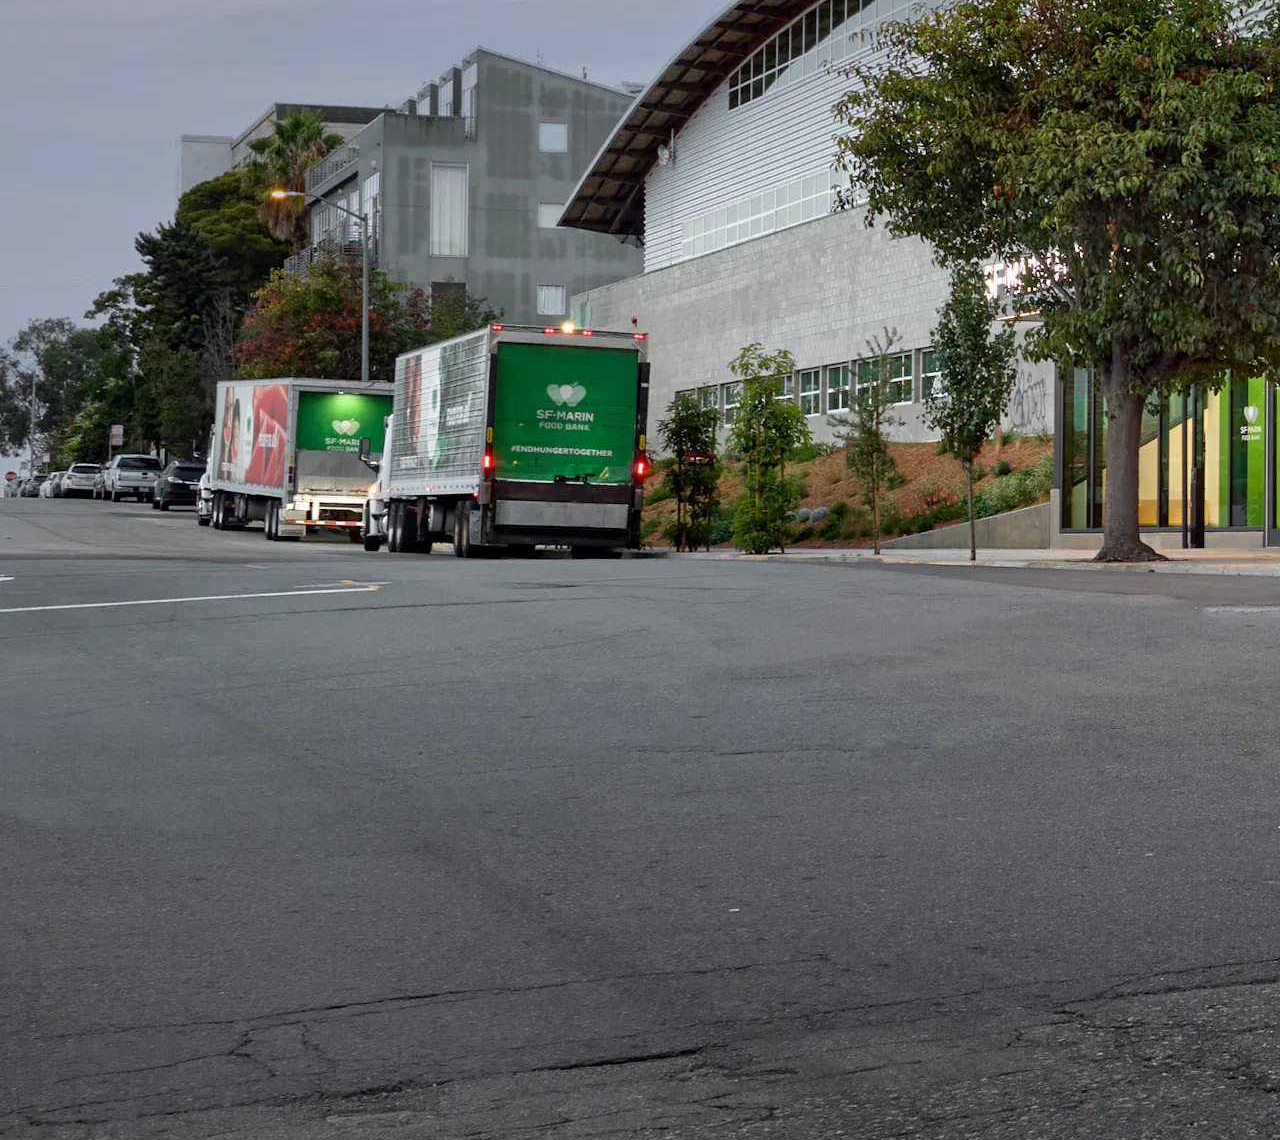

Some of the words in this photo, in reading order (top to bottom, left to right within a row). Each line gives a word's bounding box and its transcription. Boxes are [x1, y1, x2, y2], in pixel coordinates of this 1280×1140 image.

[536, 409, 594, 422] SF-MARIN
[538, 422, 563, 430] FOOD
[565, 423, 590, 431] BANK
[324, 437, 360, 446] SF-MARI
[510, 445, 613, 457] #ENDHUNGERTOGETHER
